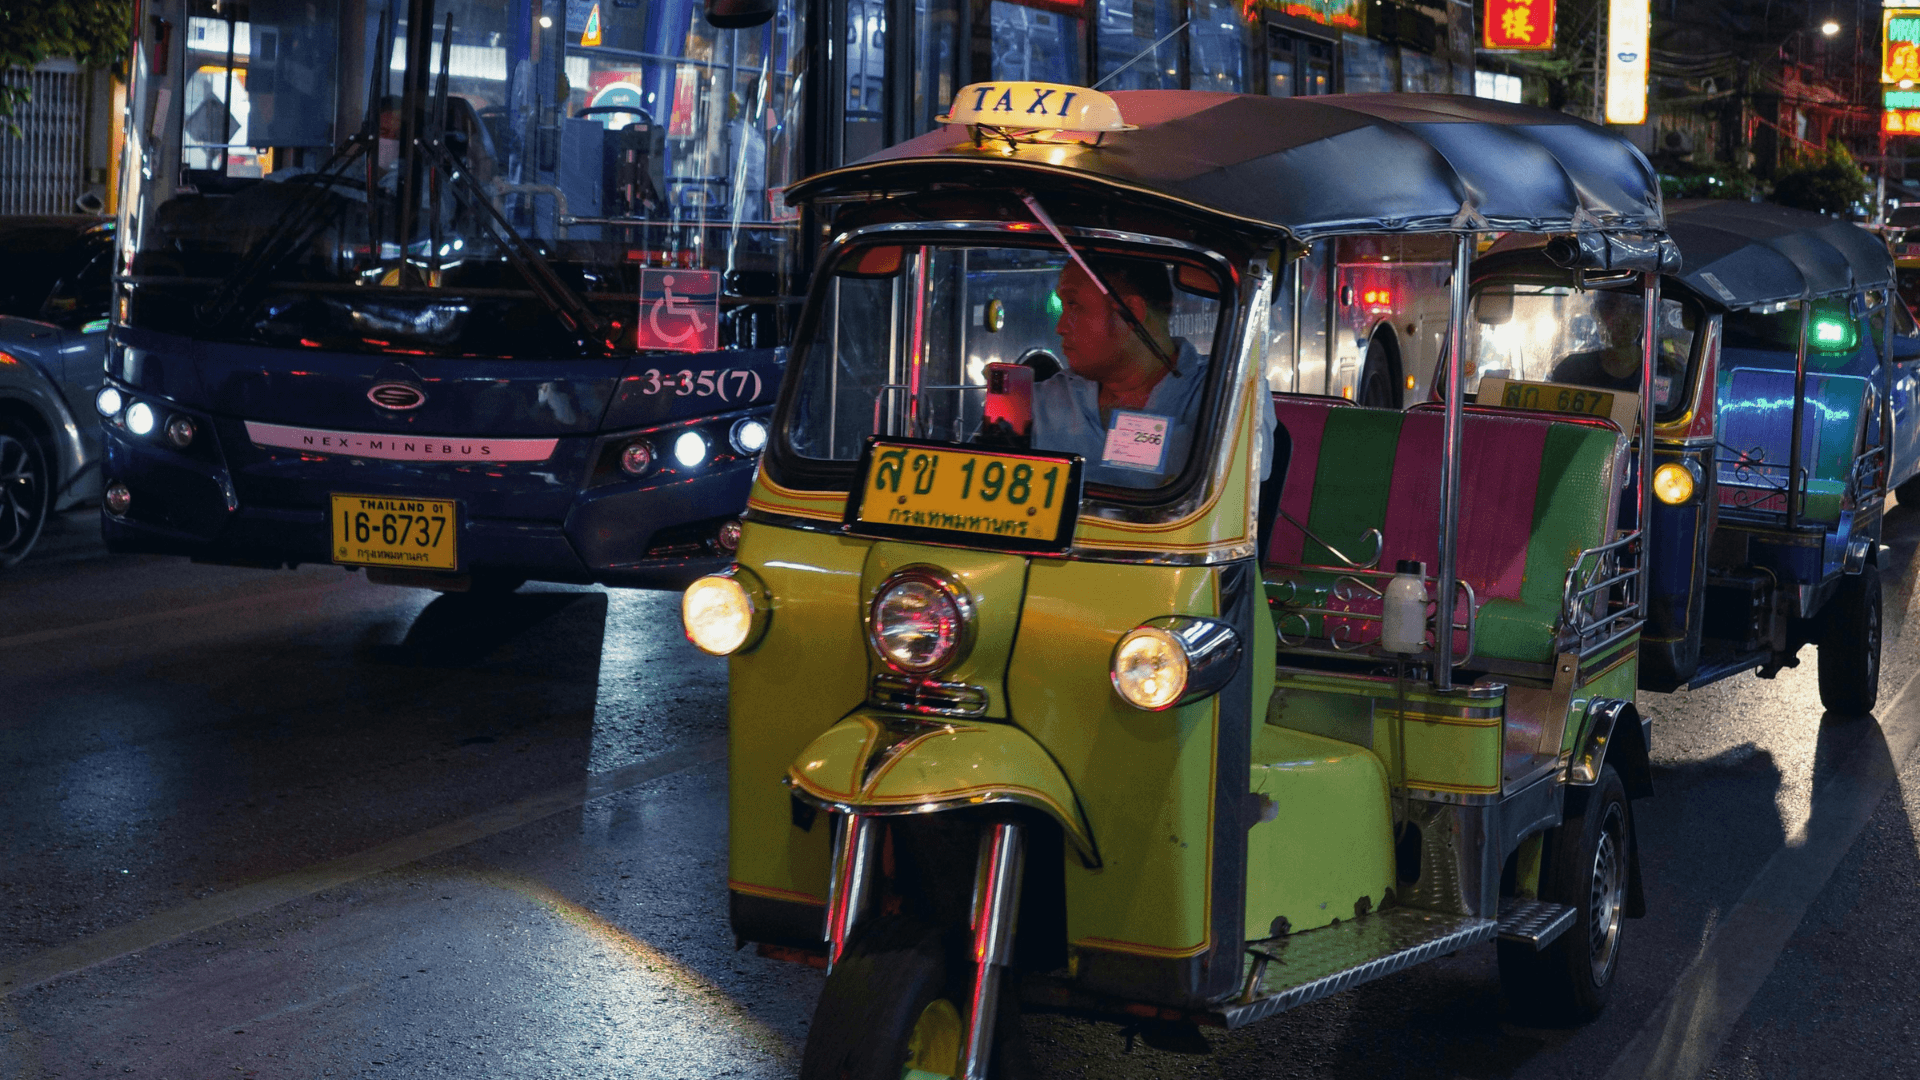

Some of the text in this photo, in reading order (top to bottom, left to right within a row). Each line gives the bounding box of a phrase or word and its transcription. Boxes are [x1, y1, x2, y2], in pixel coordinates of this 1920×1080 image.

[972, 87, 1077, 117] TAXI
[643, 368, 762, 402] 3-35(7)
[1557, 389, 1604, 414] 667
[303, 435, 491, 455] NEX-MINEBUS
[1134, 431, 1162, 446] 2566
[961, 457, 1059, 509] 1981
[360, 499, 443, 514] THAILAND 01
[344, 510, 446, 548] 16-6737
[888, 508, 1029, 536] กรงเทพมหานคร
[357, 548, 429, 563] กรุงเทพมหานคร
